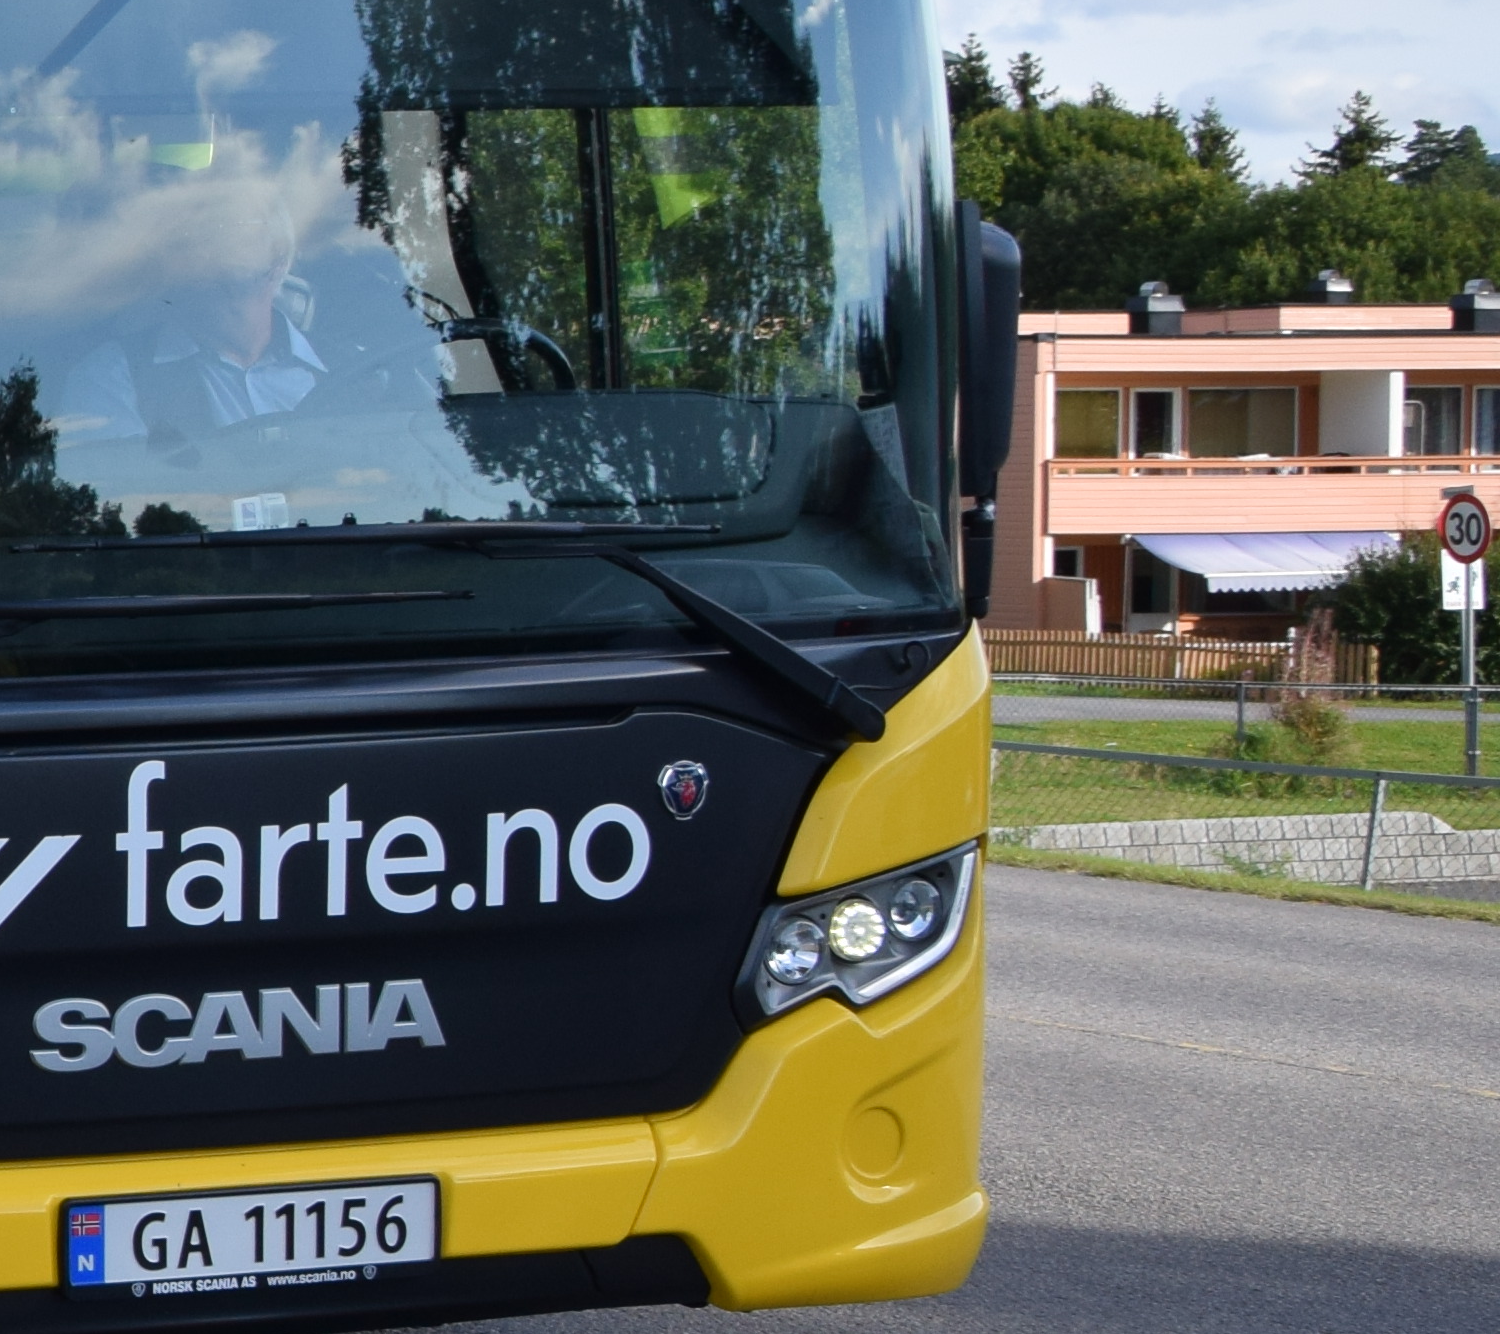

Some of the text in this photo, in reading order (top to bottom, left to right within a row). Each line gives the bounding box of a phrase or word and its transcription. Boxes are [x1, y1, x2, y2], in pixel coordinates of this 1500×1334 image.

[1448, 511, 1482, 546] 30
[115, 760, 652, 929] farte.no
[29, 978, 447, 1073] SCANIA
[77, 1254, 94, 1272] N
[131, 1193, 408, 1275] GA 11156
[152, 1269, 357, 1295] NORSK SCANIA AS www.scania.no
